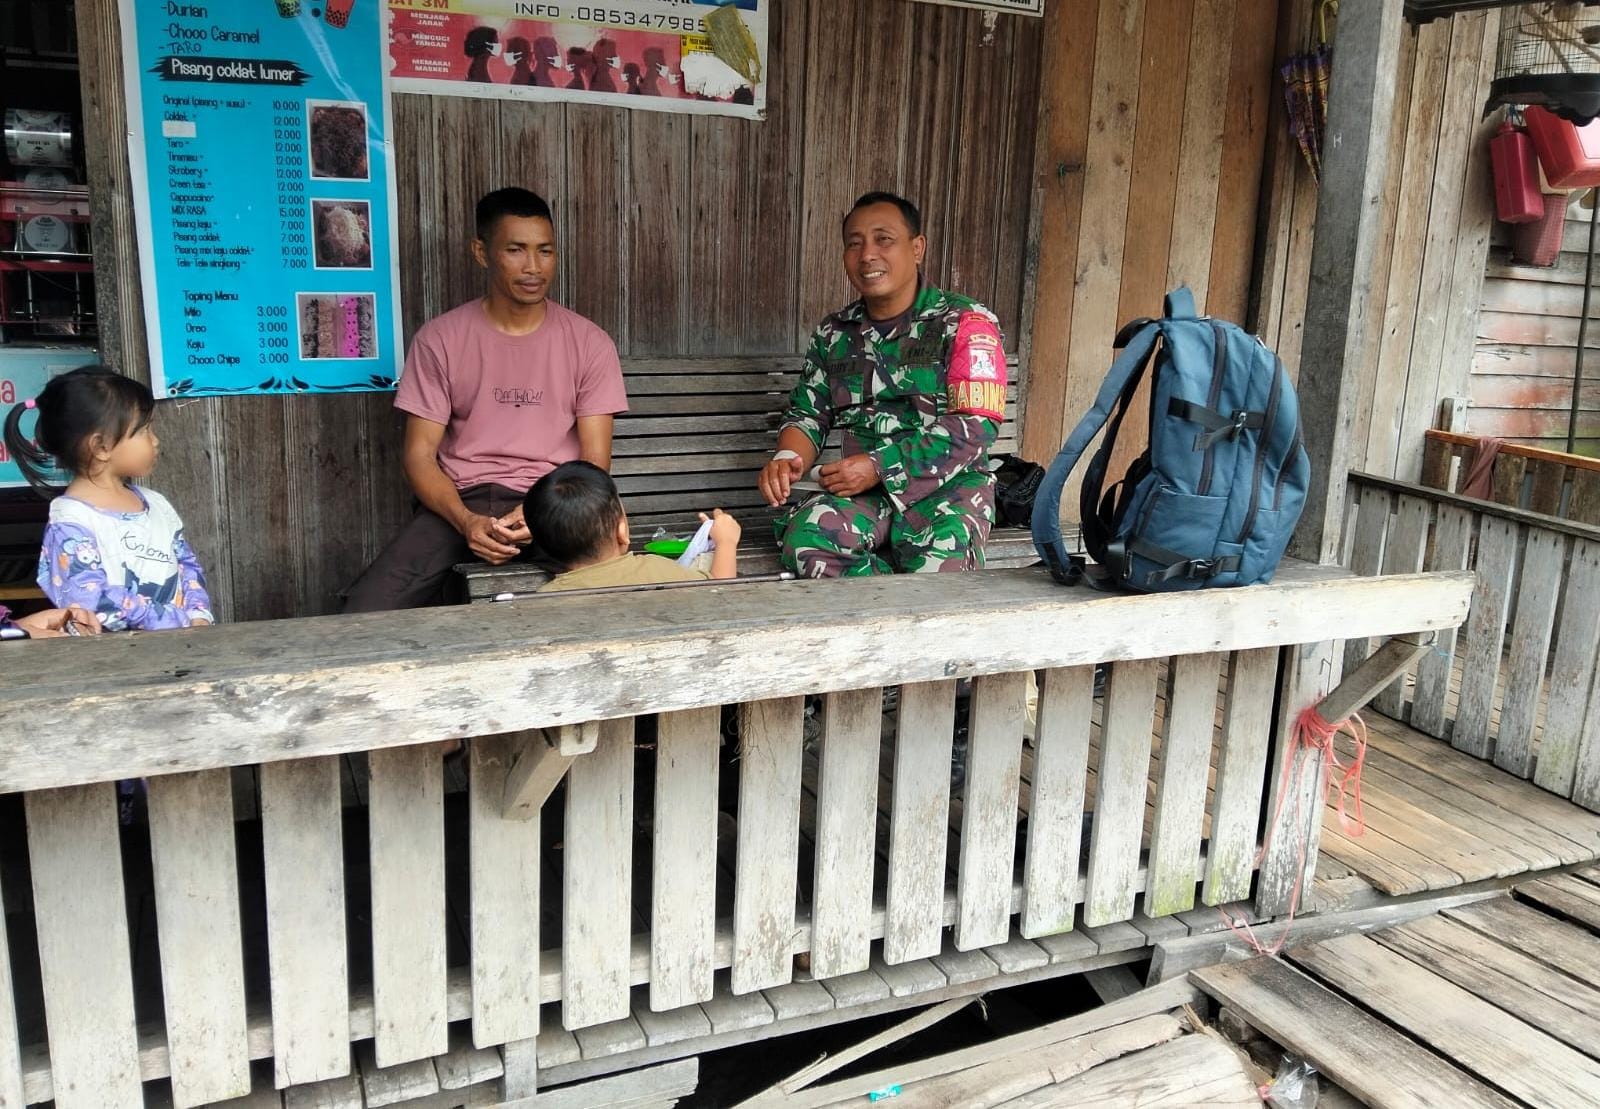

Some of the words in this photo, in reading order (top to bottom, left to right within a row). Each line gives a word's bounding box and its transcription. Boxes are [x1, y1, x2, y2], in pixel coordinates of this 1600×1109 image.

[515, 3, 560, 17] INFO
[410, 12, 450, 22] MENJAGA
[416, 19, 444, 27] JARAK
[210, 25, 260, 45] Caramel
[411, 33, 450, 42] MENCUCI
[415, 40, 447, 48] TANGAN
[411, 59, 451, 67] MEMAKAI
[171, 58, 213, 81] Pisang
[216, 61, 257, 79] coklat
[259, 62, 295, 81] lumer
[414, 65, 449, 73] MASKER
[163, 95, 190, 107] Original
[273, 101, 300, 112] 10.000
[274, 117, 301, 127] 12.000
[274, 129, 301, 140] 12.000
[275, 143, 302, 153] 12.000
[276, 156, 302, 166] 12.000
[276, 169, 303, 179] 12.000
[278, 182, 304, 192] 12.000
[279, 195, 305, 205] 12.000
[171, 205, 186, 215] MIX
[187, 206, 207, 216] RASA
[279, 208, 306, 217] 15.000
[172, 218, 196, 231] Pisang
[280, 221, 305, 230] 7.000
[173, 231, 197, 244] Pisang
[281, 234, 305, 243] 7.000
[175, 245, 198, 257] Pisang
[281, 246, 308, 256] 10.000
[282, 259, 307, 269] 7.000
[214, 290, 239, 301] Menu
[256, 305, 287, 317] 3.000
[185, 323, 207, 333] Oreo
[257, 321, 288, 333] 3.000
[186, 338, 205, 352] Keju
[258, 337, 289, 348] 3.000
[216, 353, 240, 367] Chips
[258, 353, 289, 364] 3.000
[948, 380, 1008, 416] ABINS
